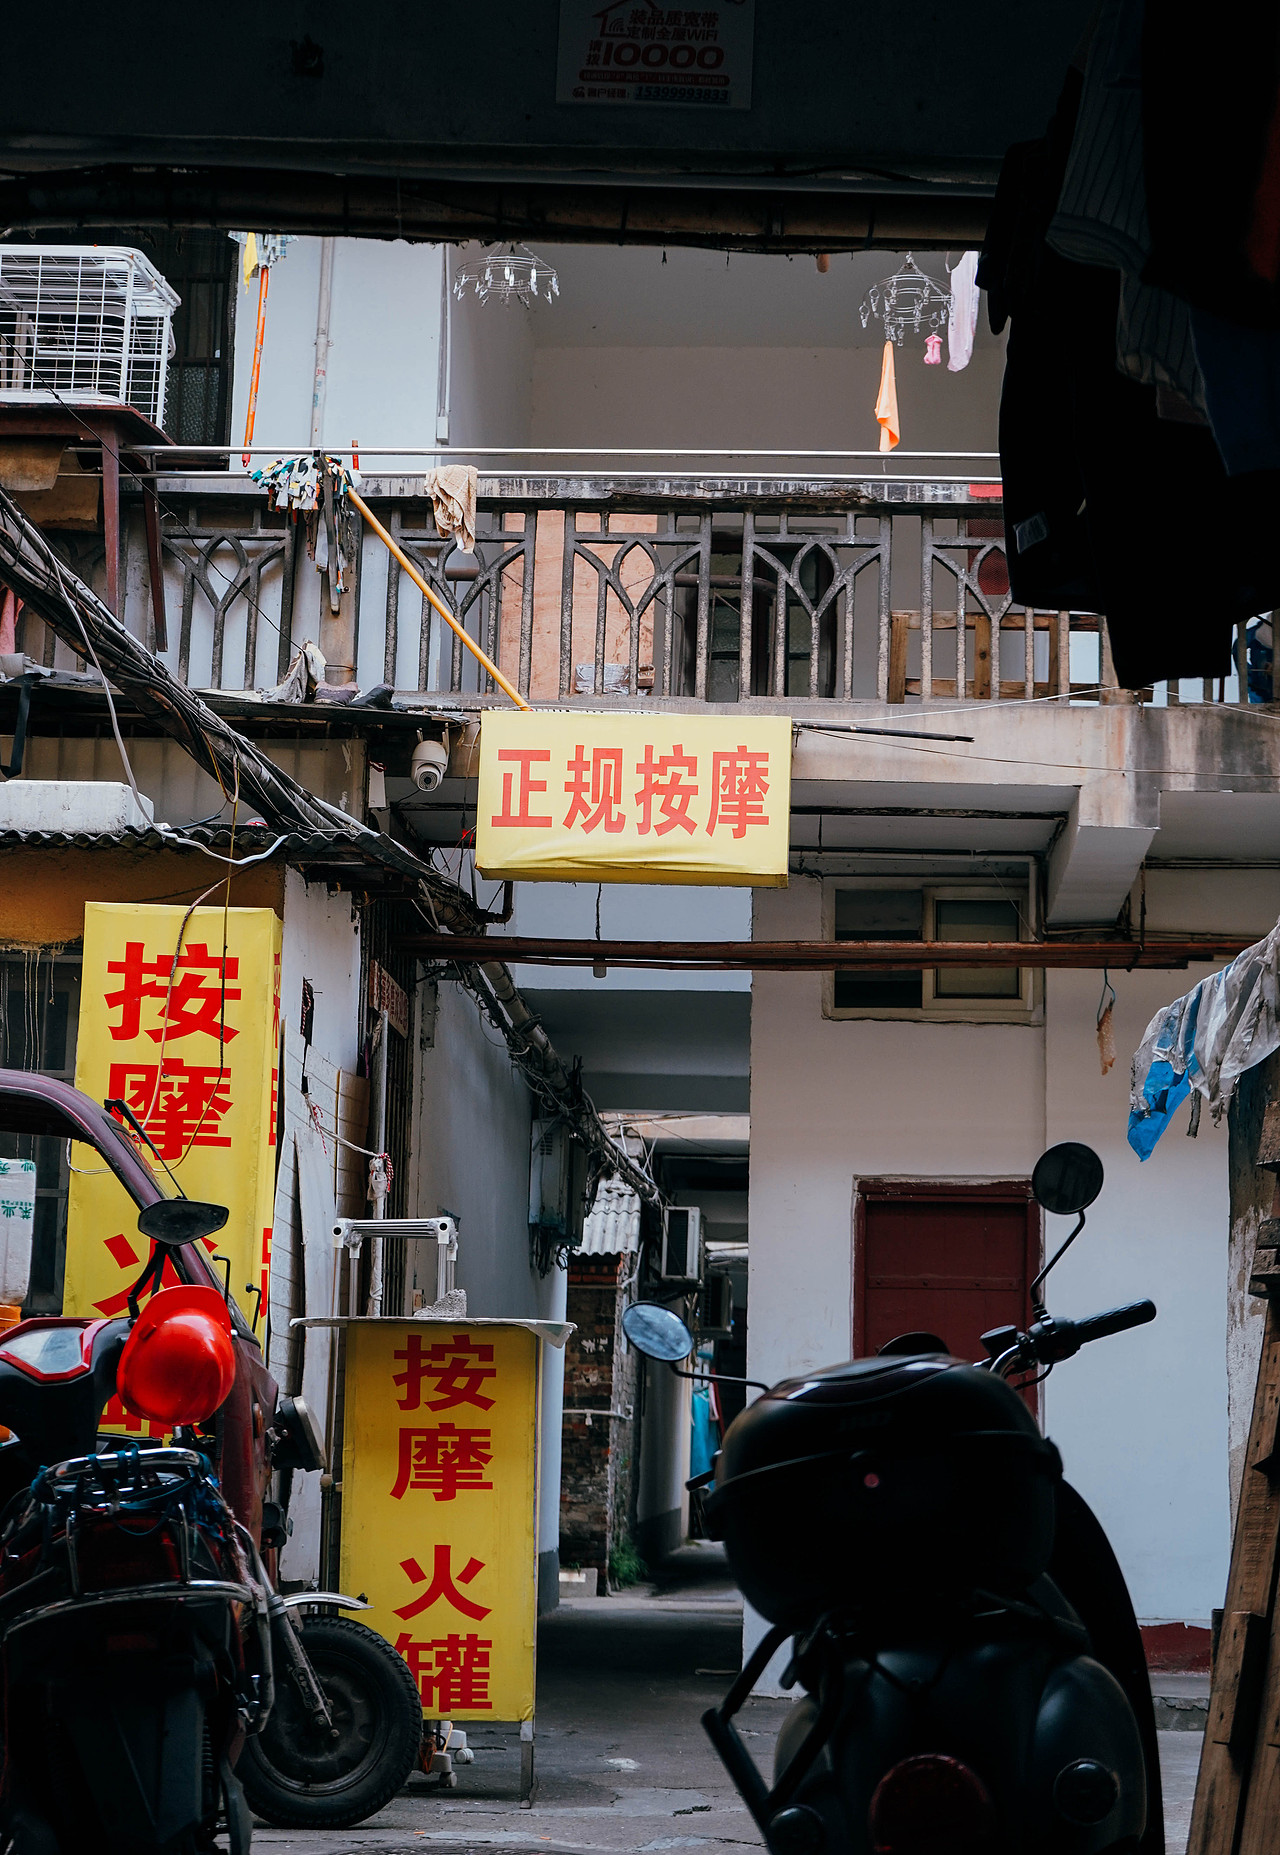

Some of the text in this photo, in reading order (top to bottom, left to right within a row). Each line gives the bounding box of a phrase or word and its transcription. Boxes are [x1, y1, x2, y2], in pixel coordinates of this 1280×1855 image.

[602, 42, 724, 69] 10000
[491, 744, 770, 839] 正规按摩
[98, 941, 242, 1161] 按摩
[389, 1334, 497, 1713] 按摩 火罐
